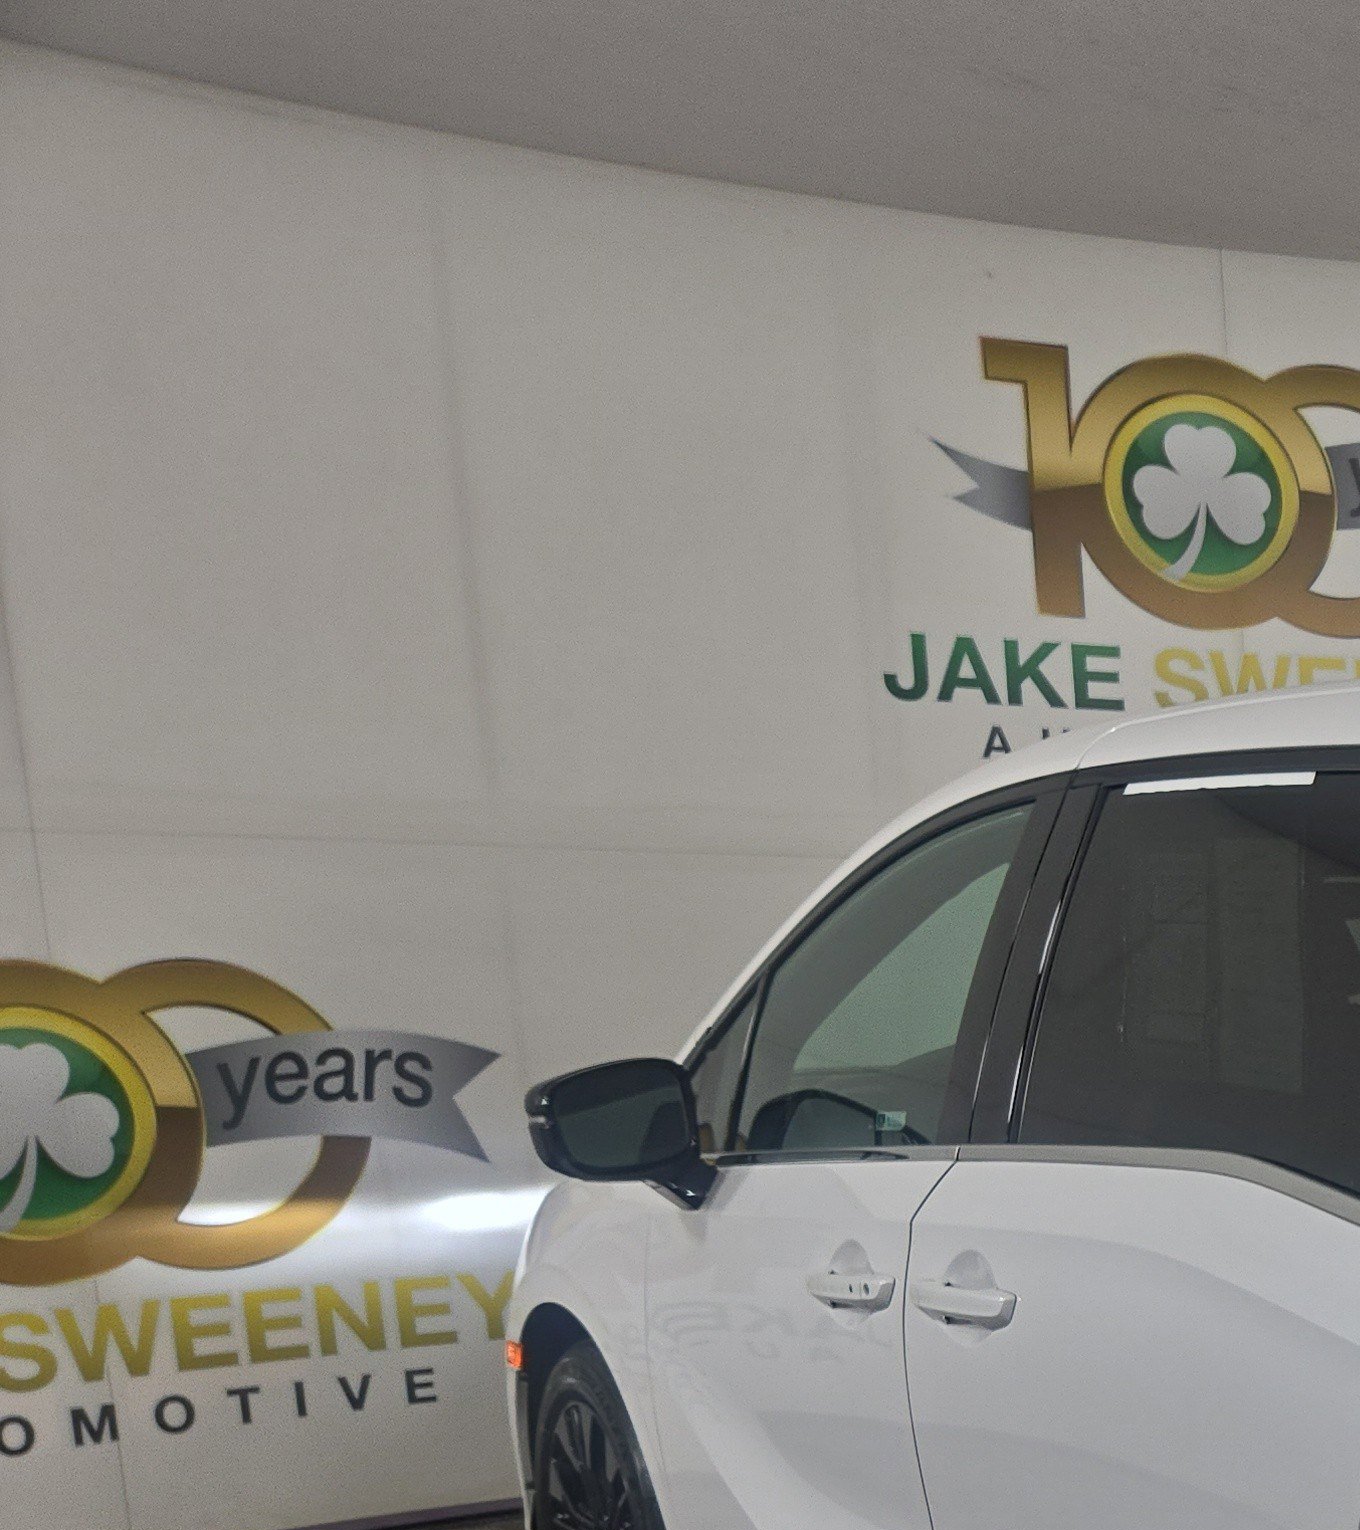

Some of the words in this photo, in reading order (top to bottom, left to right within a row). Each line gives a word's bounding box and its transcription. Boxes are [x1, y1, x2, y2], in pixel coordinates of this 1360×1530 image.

[884, 631, 1126, 711] JAKE
[217, 1046, 433, 1130] years
[0, 1270, 514, 1394] SWEENEY
